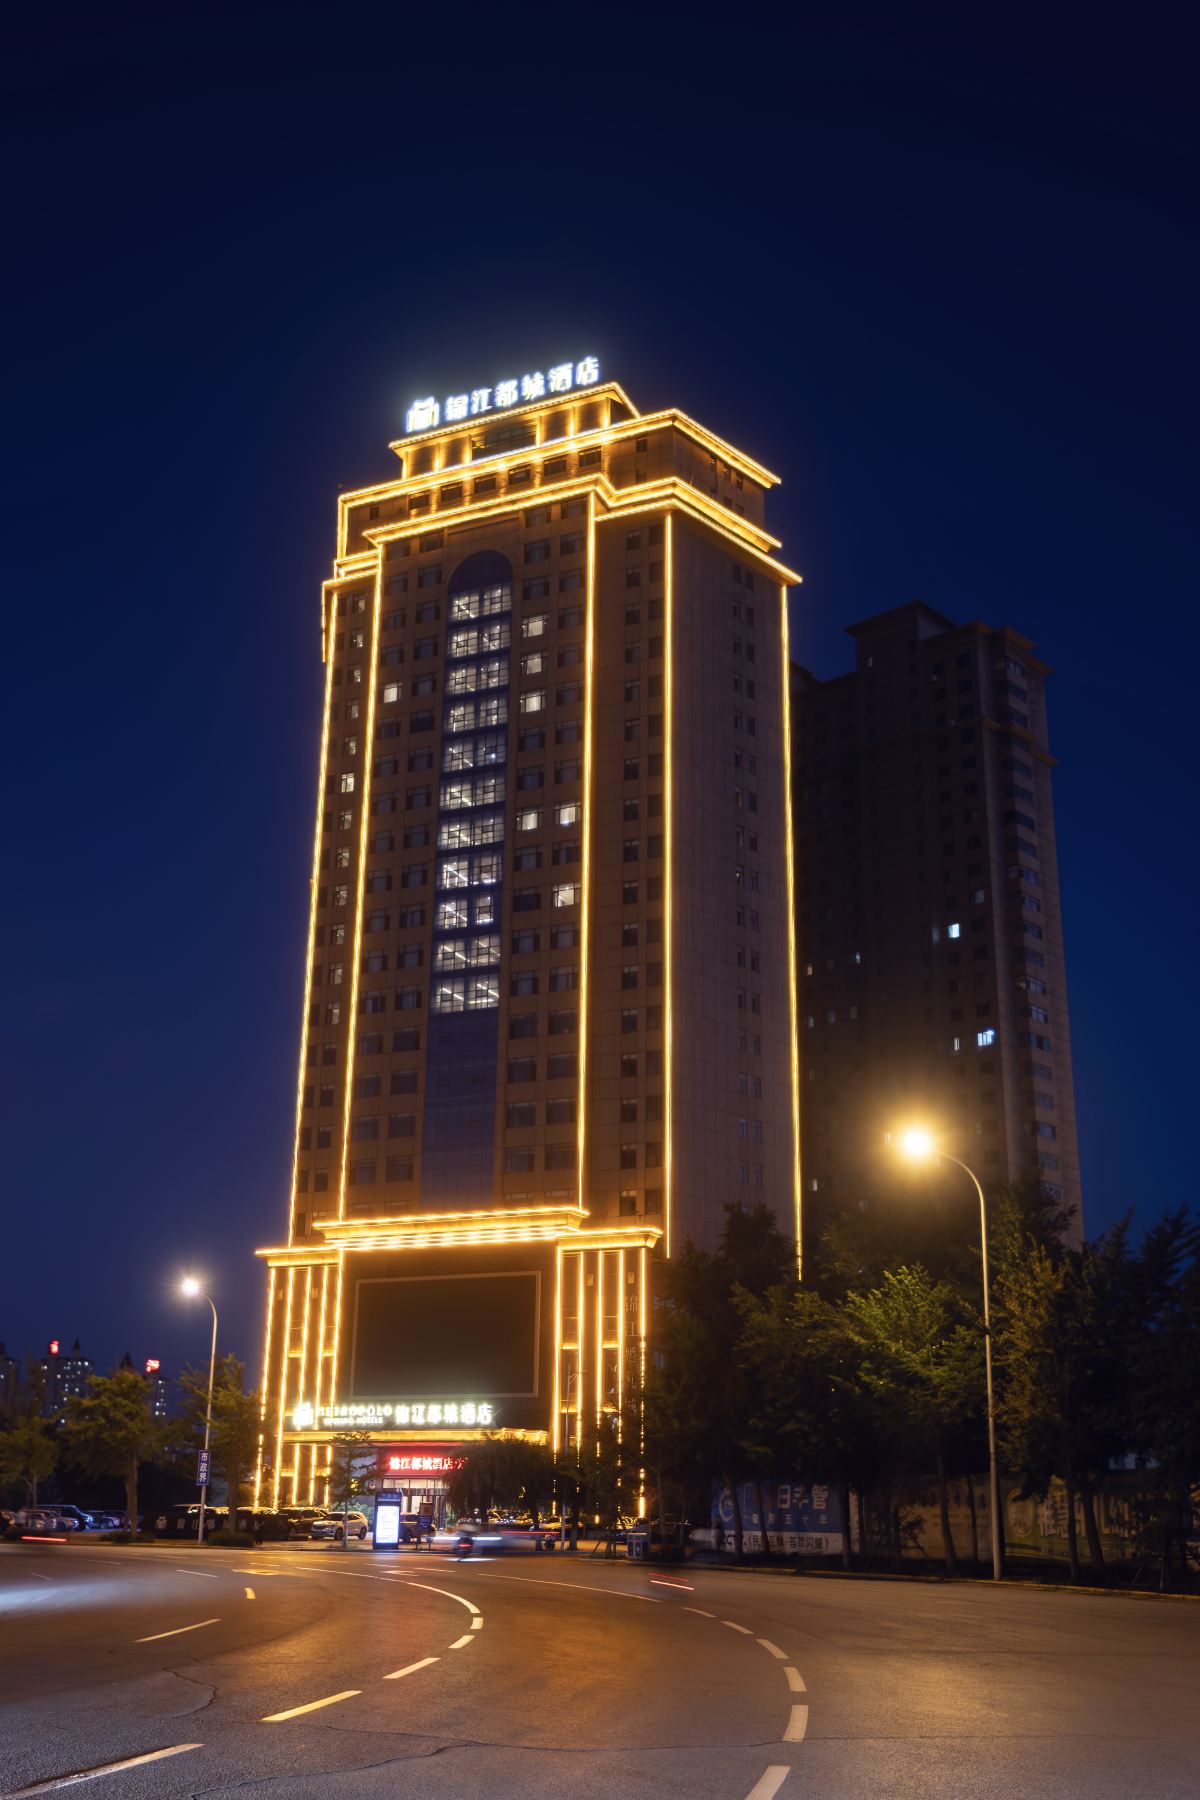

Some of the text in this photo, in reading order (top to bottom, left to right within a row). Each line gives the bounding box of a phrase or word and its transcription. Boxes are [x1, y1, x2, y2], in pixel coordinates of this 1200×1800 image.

[445, 356, 599, 421] 锦江都城酒店
